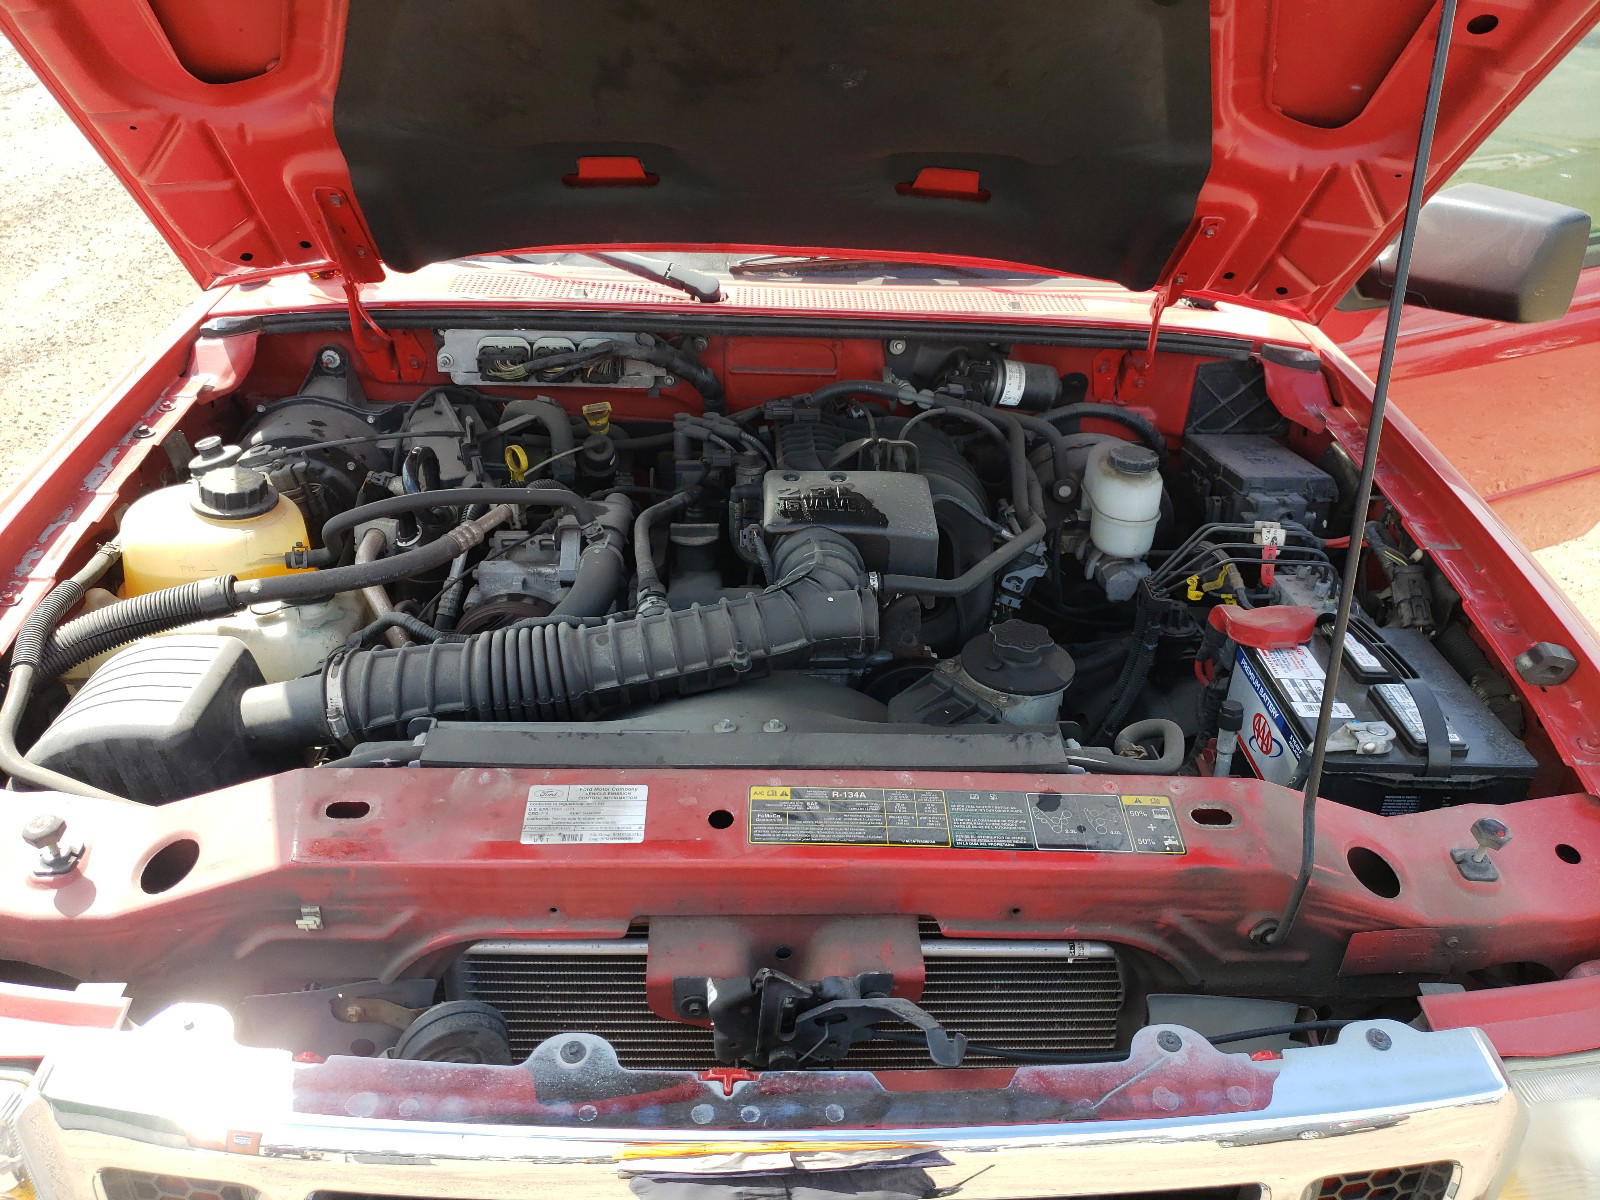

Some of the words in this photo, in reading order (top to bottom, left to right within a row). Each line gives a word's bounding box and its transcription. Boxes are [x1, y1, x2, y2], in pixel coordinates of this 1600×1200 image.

[1240, 658, 1261, 690] PREMIUM
[1259, 686, 1280, 719] BATTERY
[1253, 713, 1273, 755] AAA
[832, 791, 866, 799] R-134A
